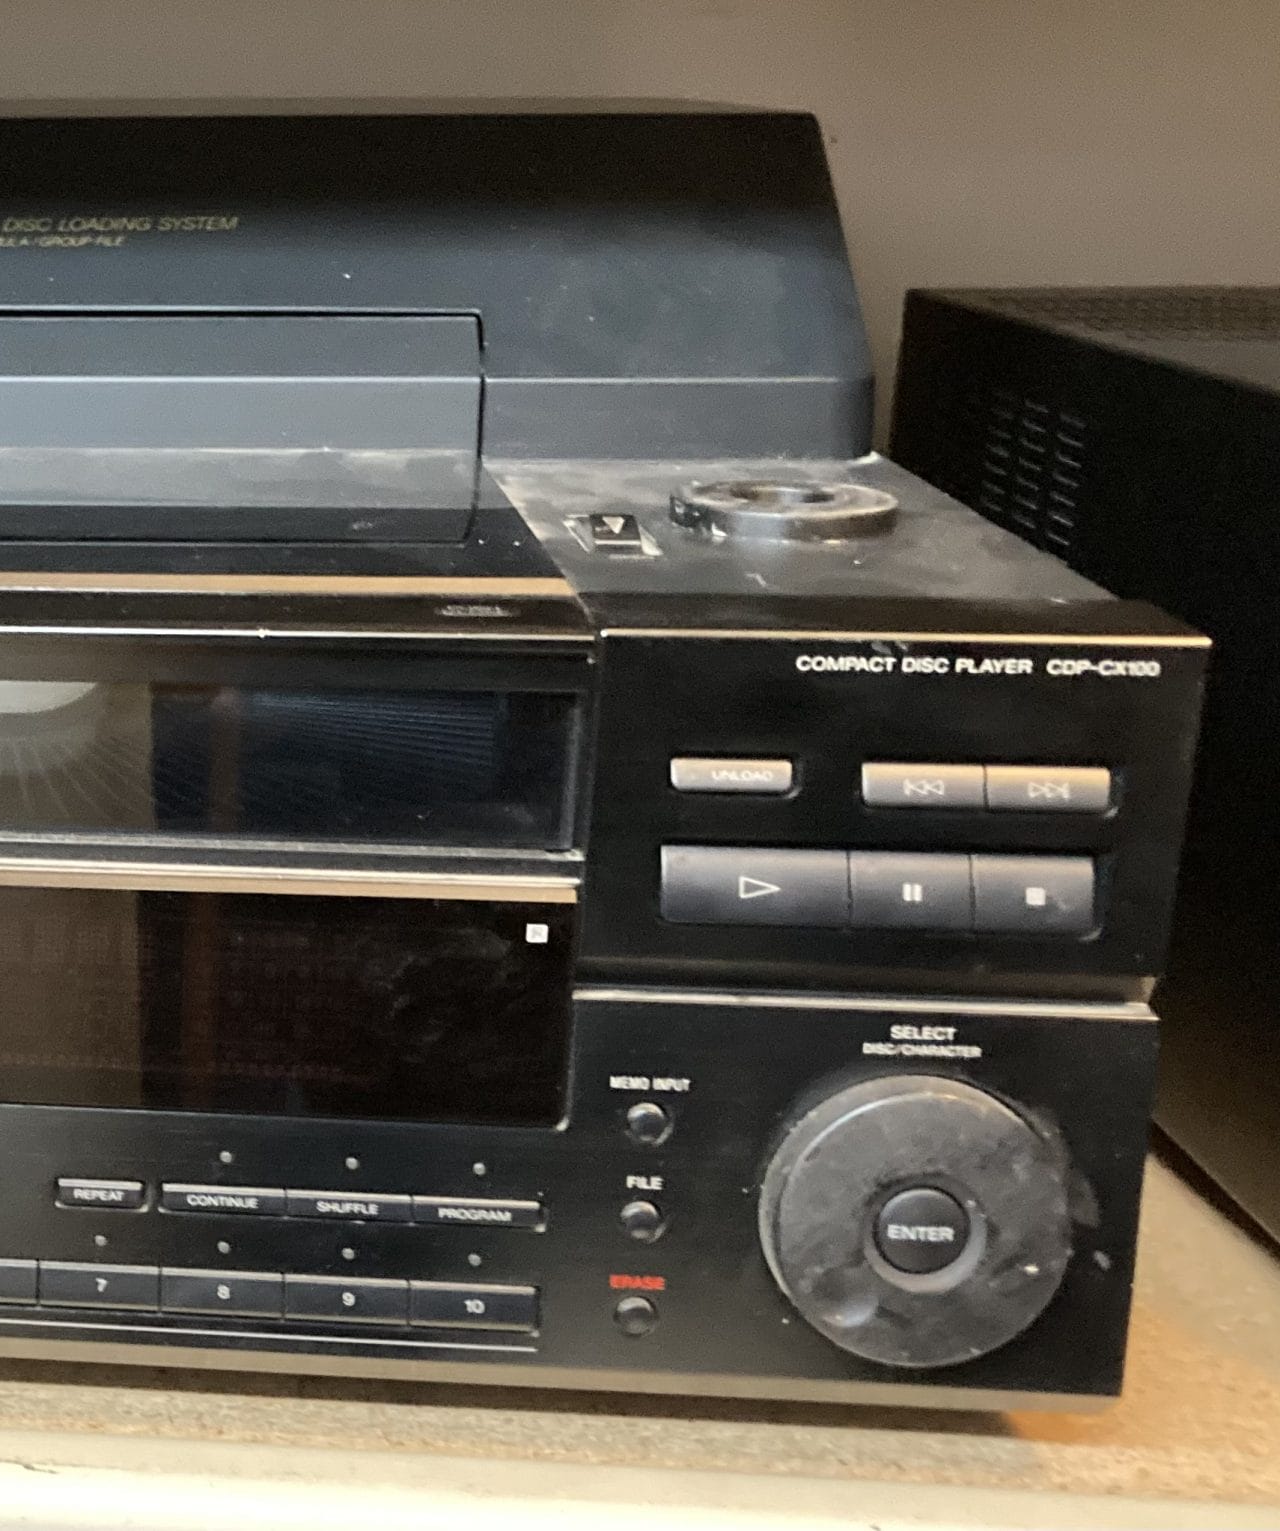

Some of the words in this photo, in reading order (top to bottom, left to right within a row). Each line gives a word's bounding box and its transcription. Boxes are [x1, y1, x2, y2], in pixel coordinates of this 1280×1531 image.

[3, 217, 53, 232] DISC
[58, 217, 152, 232] LOADING
[157, 216, 239, 231] SYSTEM
[795, 656, 896, 672] COMPACT
[901, 657, 950, 673] DISC
[955, 658, 1033, 675] PLAYER
[1046, 659, 1161, 677] CDP-CX100
[890, 1025, 958, 1041] SELECT
[609, 1075, 650, 1090] MEMO
[652, 1077, 691, 1091] INPUT
[625, 1175, 664, 1191] FILE
[73, 1188, 126, 1203] REPEAT
[186, 1195, 259, 1210] CONTINUE
[316, 1201, 380, 1216] SHUFFLE
[437, 1208, 513, 1223] PROGRAM
[886, 1223, 956, 1242] ENTER
[95, 1278, 108, 1293] 7
[217, 1285, 230, 1300] 8
[342, 1292, 355, 1307] 9
[464, 1300, 485, 1315] 10
